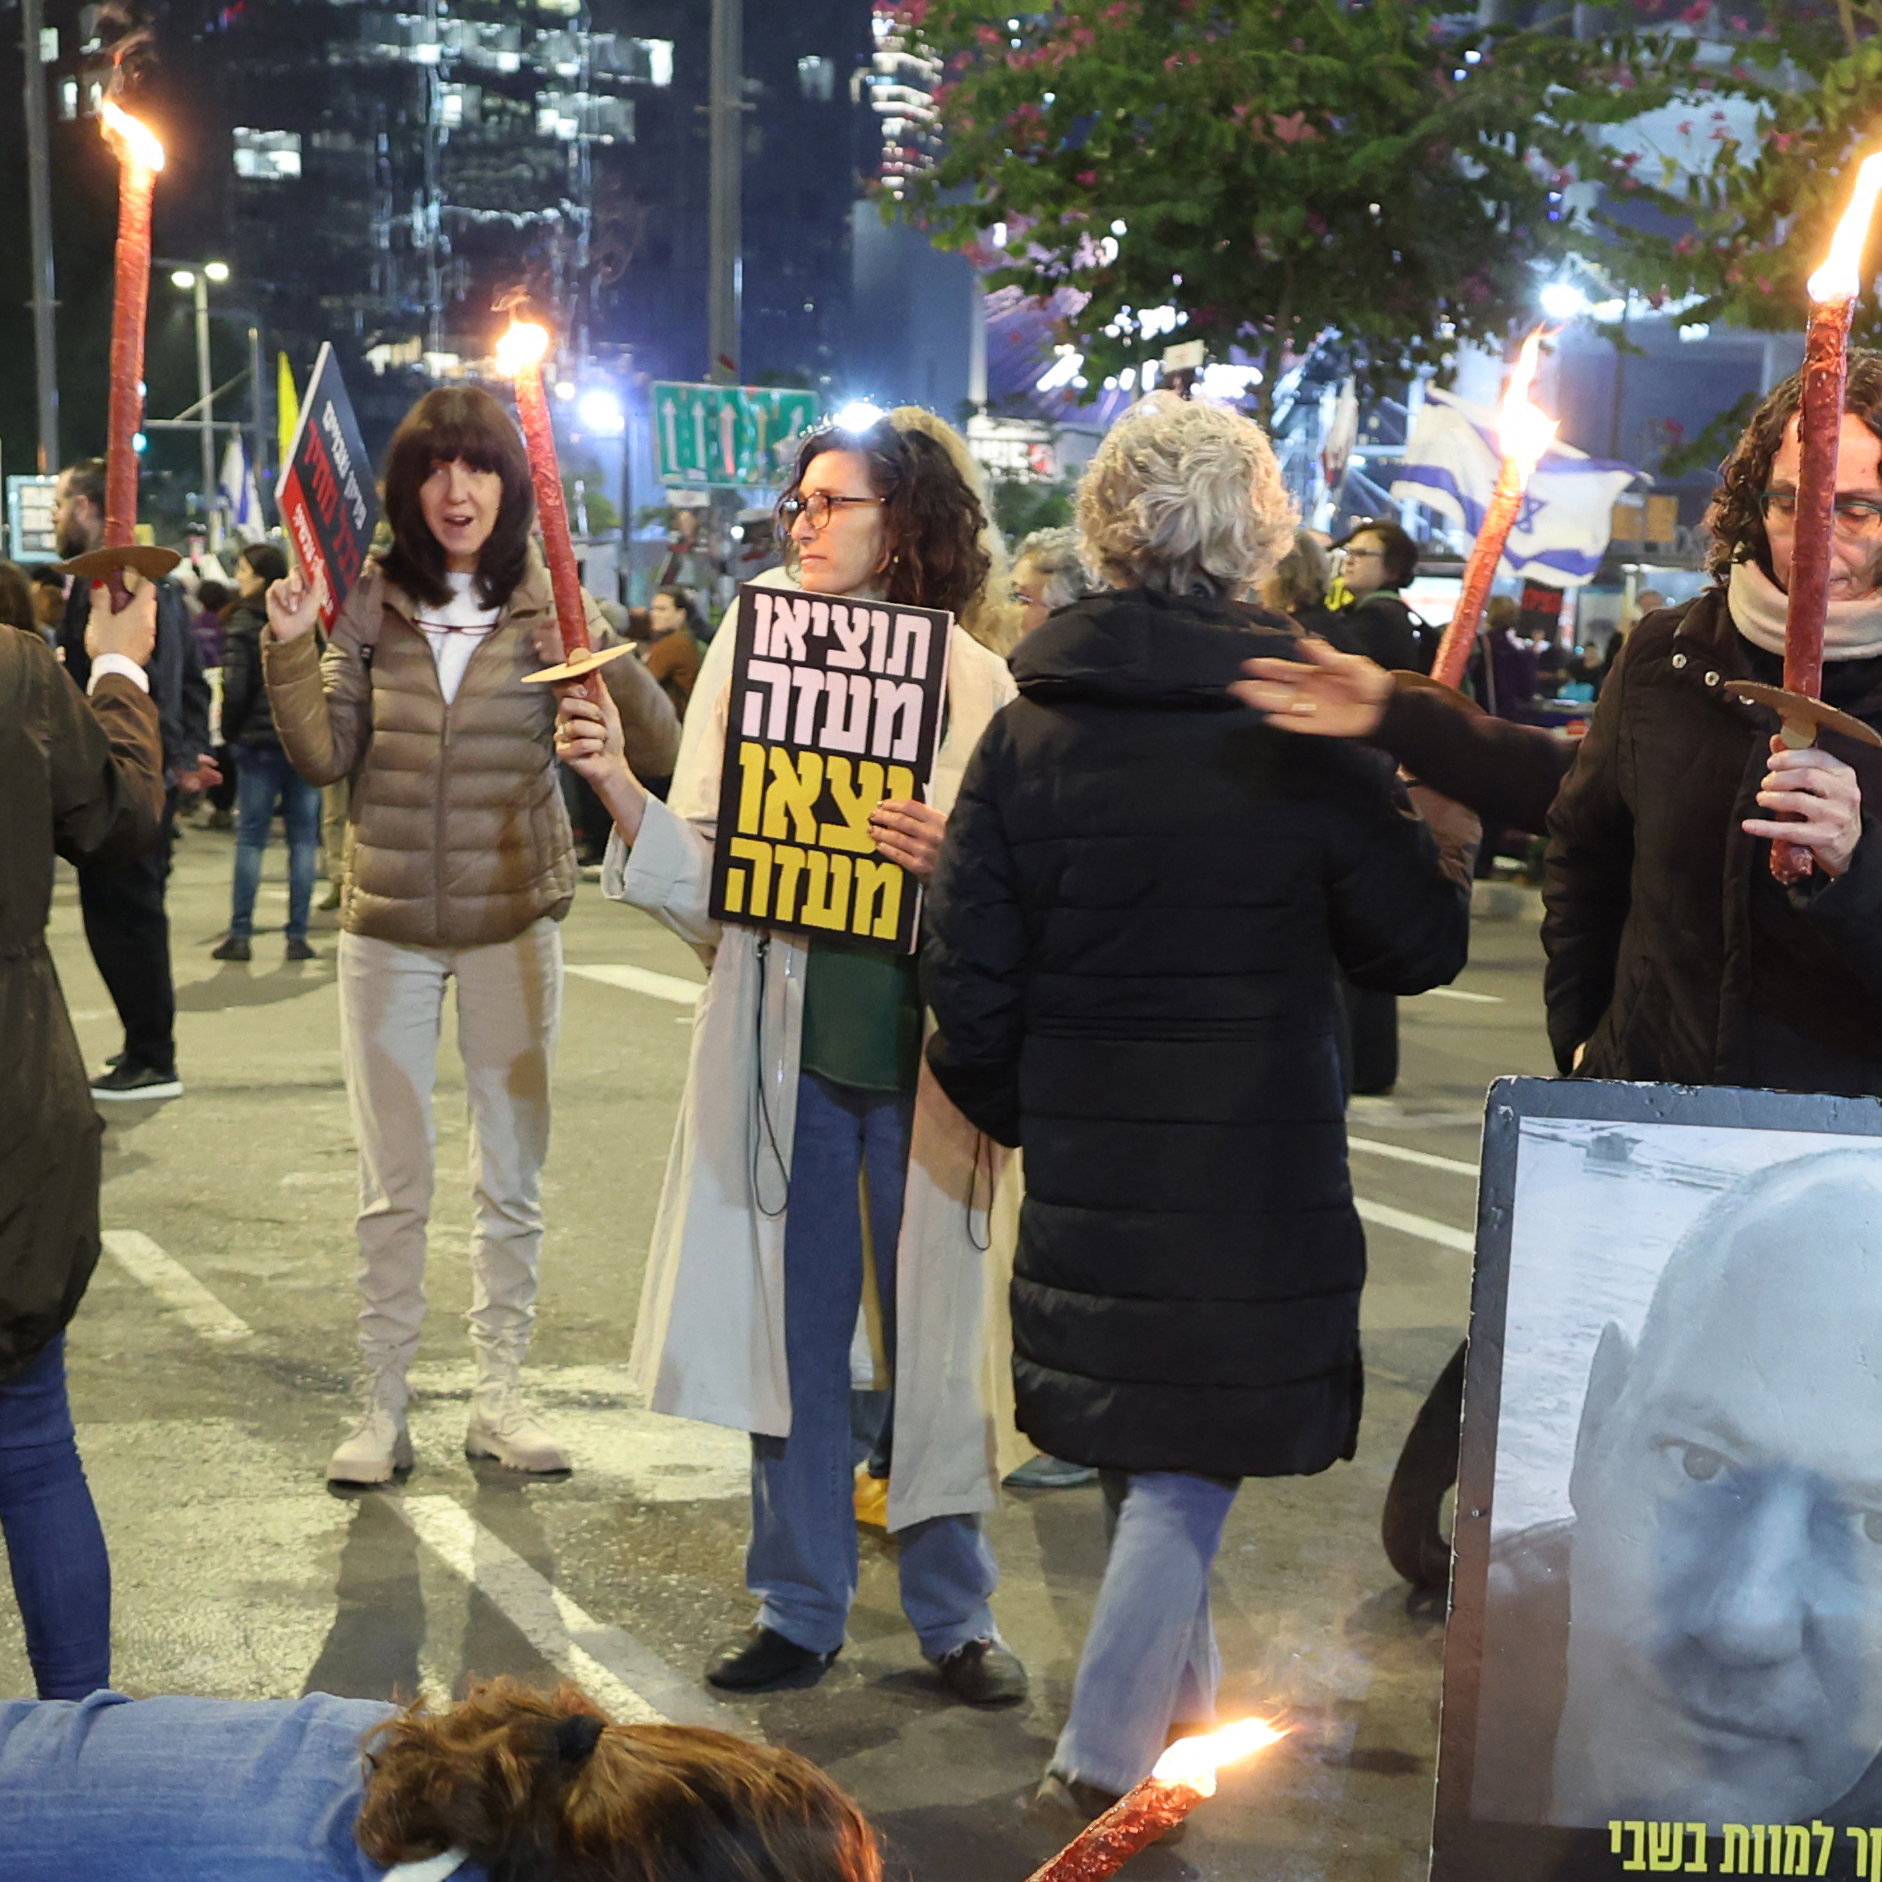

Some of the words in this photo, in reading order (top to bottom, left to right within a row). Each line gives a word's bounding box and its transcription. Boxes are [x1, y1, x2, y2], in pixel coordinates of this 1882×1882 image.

[753, 593, 932, 680] תוציאו
[741, 658, 924, 763] מעזה
[723, 837, 903, 941] מעזה
[1607, 1819, 1709, 1873] בשבי
[1718, 1819, 1835, 1877] למוות
